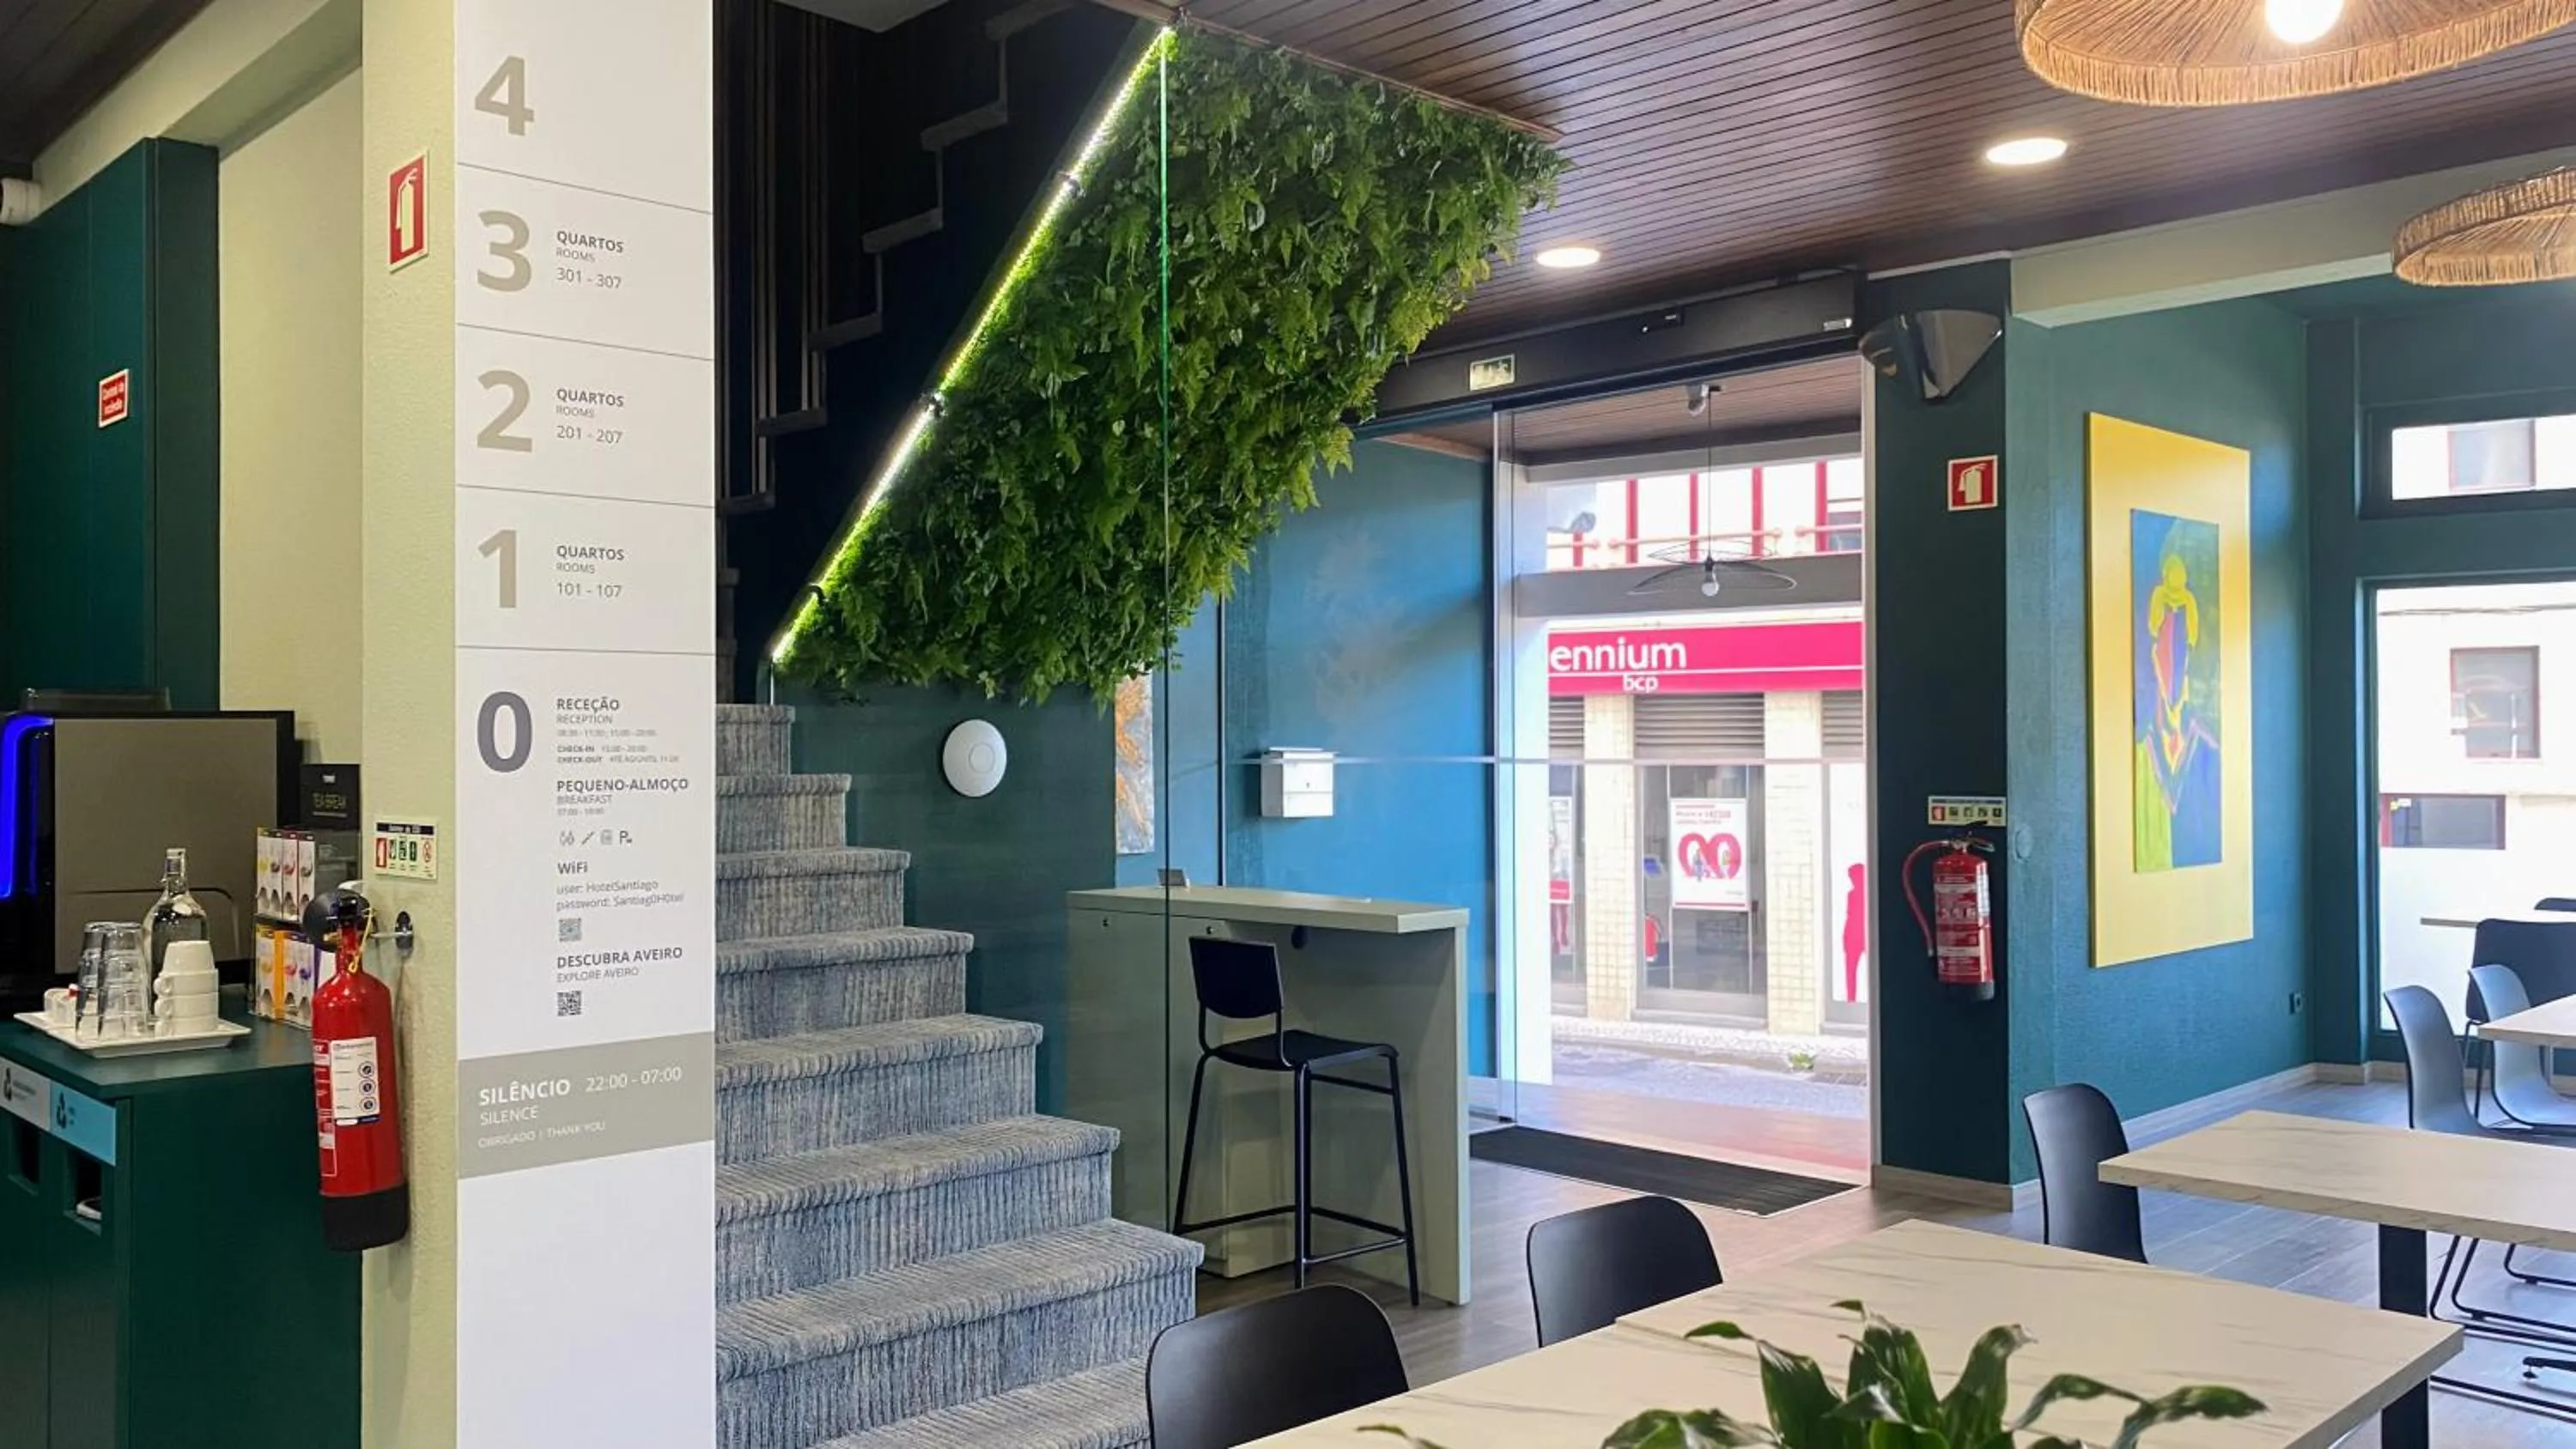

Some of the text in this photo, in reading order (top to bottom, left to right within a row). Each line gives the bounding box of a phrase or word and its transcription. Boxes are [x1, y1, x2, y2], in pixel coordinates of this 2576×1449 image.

[475, 55, 534, 136] 4
[556, 230, 624, 253] QUARTOS
[477, 210, 532, 292] 3
[556, 247, 595, 263] ROOMS
[556, 268, 582, 283] 301
[596, 274, 622, 289] 307
[556, 388, 624, 407] QUARTOS
[477, 369, 532, 452] 2
[556, 405, 594, 418] ROOMS
[556, 426, 581, 440] 201
[596, 428, 623, 444] 207
[556, 545, 625, 561] QUARTOS
[477, 529, 517, 609] 1
[556, 562, 595, 574] ROOMS
[556, 582, 581, 596] 101
[596, 585, 622, 598] 107
[1550, 636, 1687, 671] ennium
[1623, 674, 1659, 693] bcp
[556, 696, 620, 714] RECEÇÃO
[556, 714, 613, 724] RECEPTION
[477, 691, 532, 773] 0
[556, 778, 690, 793] PEQUENO-ALMOÇO
[556, 794, 613, 805] BREAKFAST
[556, 861, 588, 875] WiFi
[556, 947, 683, 969] DESCUBRA AVEIRO
[556, 967, 640, 984] EXPLORE AVEIRO
[478, 1079, 571, 1106] SILÊNCIO
[585, 1073, 628, 1093] 22:00
[640, 1066, 682, 1085] 07:00
[479, 1105, 539, 1127] SILENCE
[547, 1123, 581, 1139] THANK
